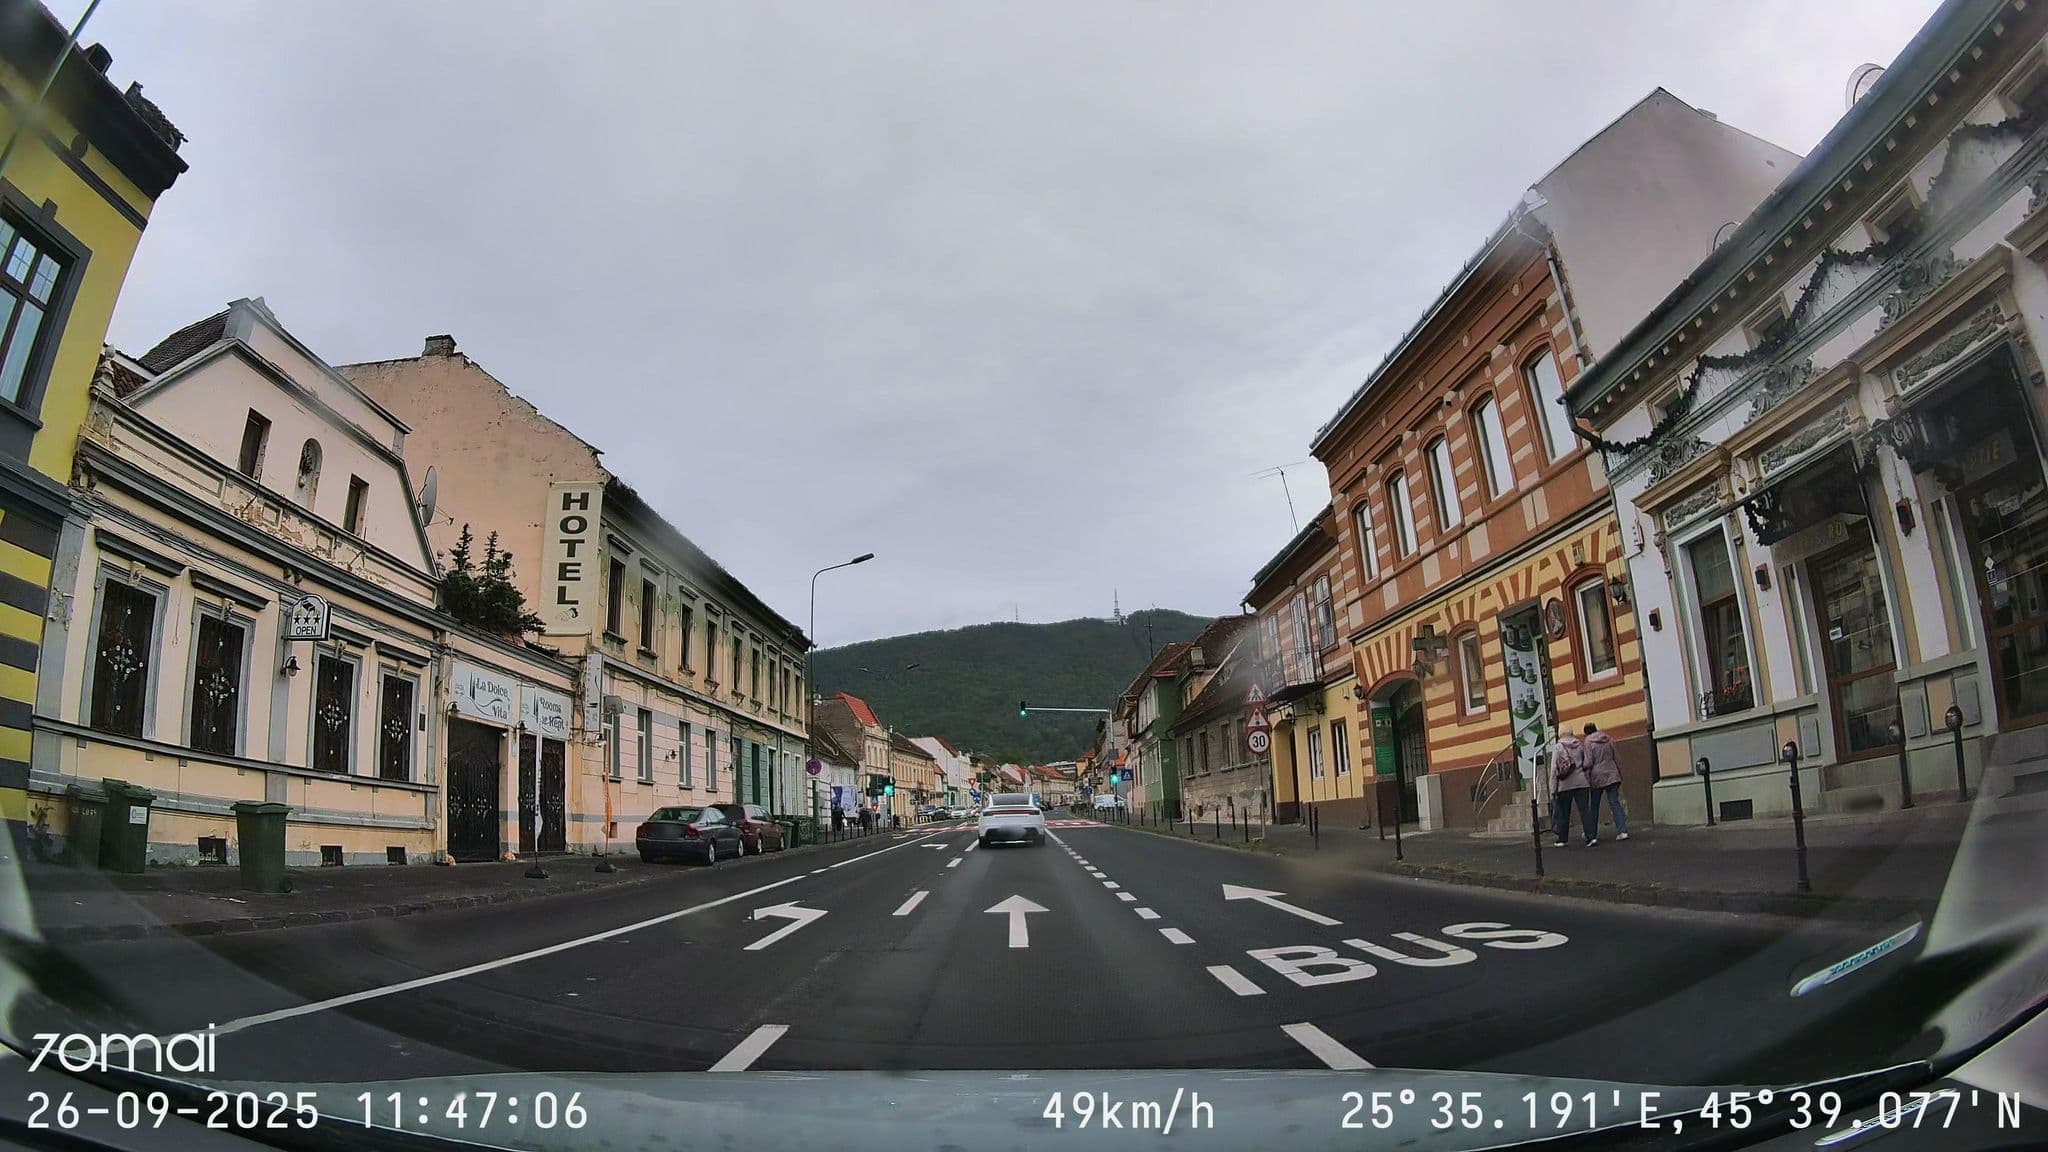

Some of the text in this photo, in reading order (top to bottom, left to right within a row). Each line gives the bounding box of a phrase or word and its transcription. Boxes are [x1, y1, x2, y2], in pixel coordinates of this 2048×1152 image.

[557, 492, 589, 605] HOTEL
[295, 625, 317, 635] OPEN
[487, 681, 509, 698] Dolce
[492, 704, 508, 719] Vita
[1252, 735, 1266, 748] 30
[1246, 922, 1569, 987] BUS
